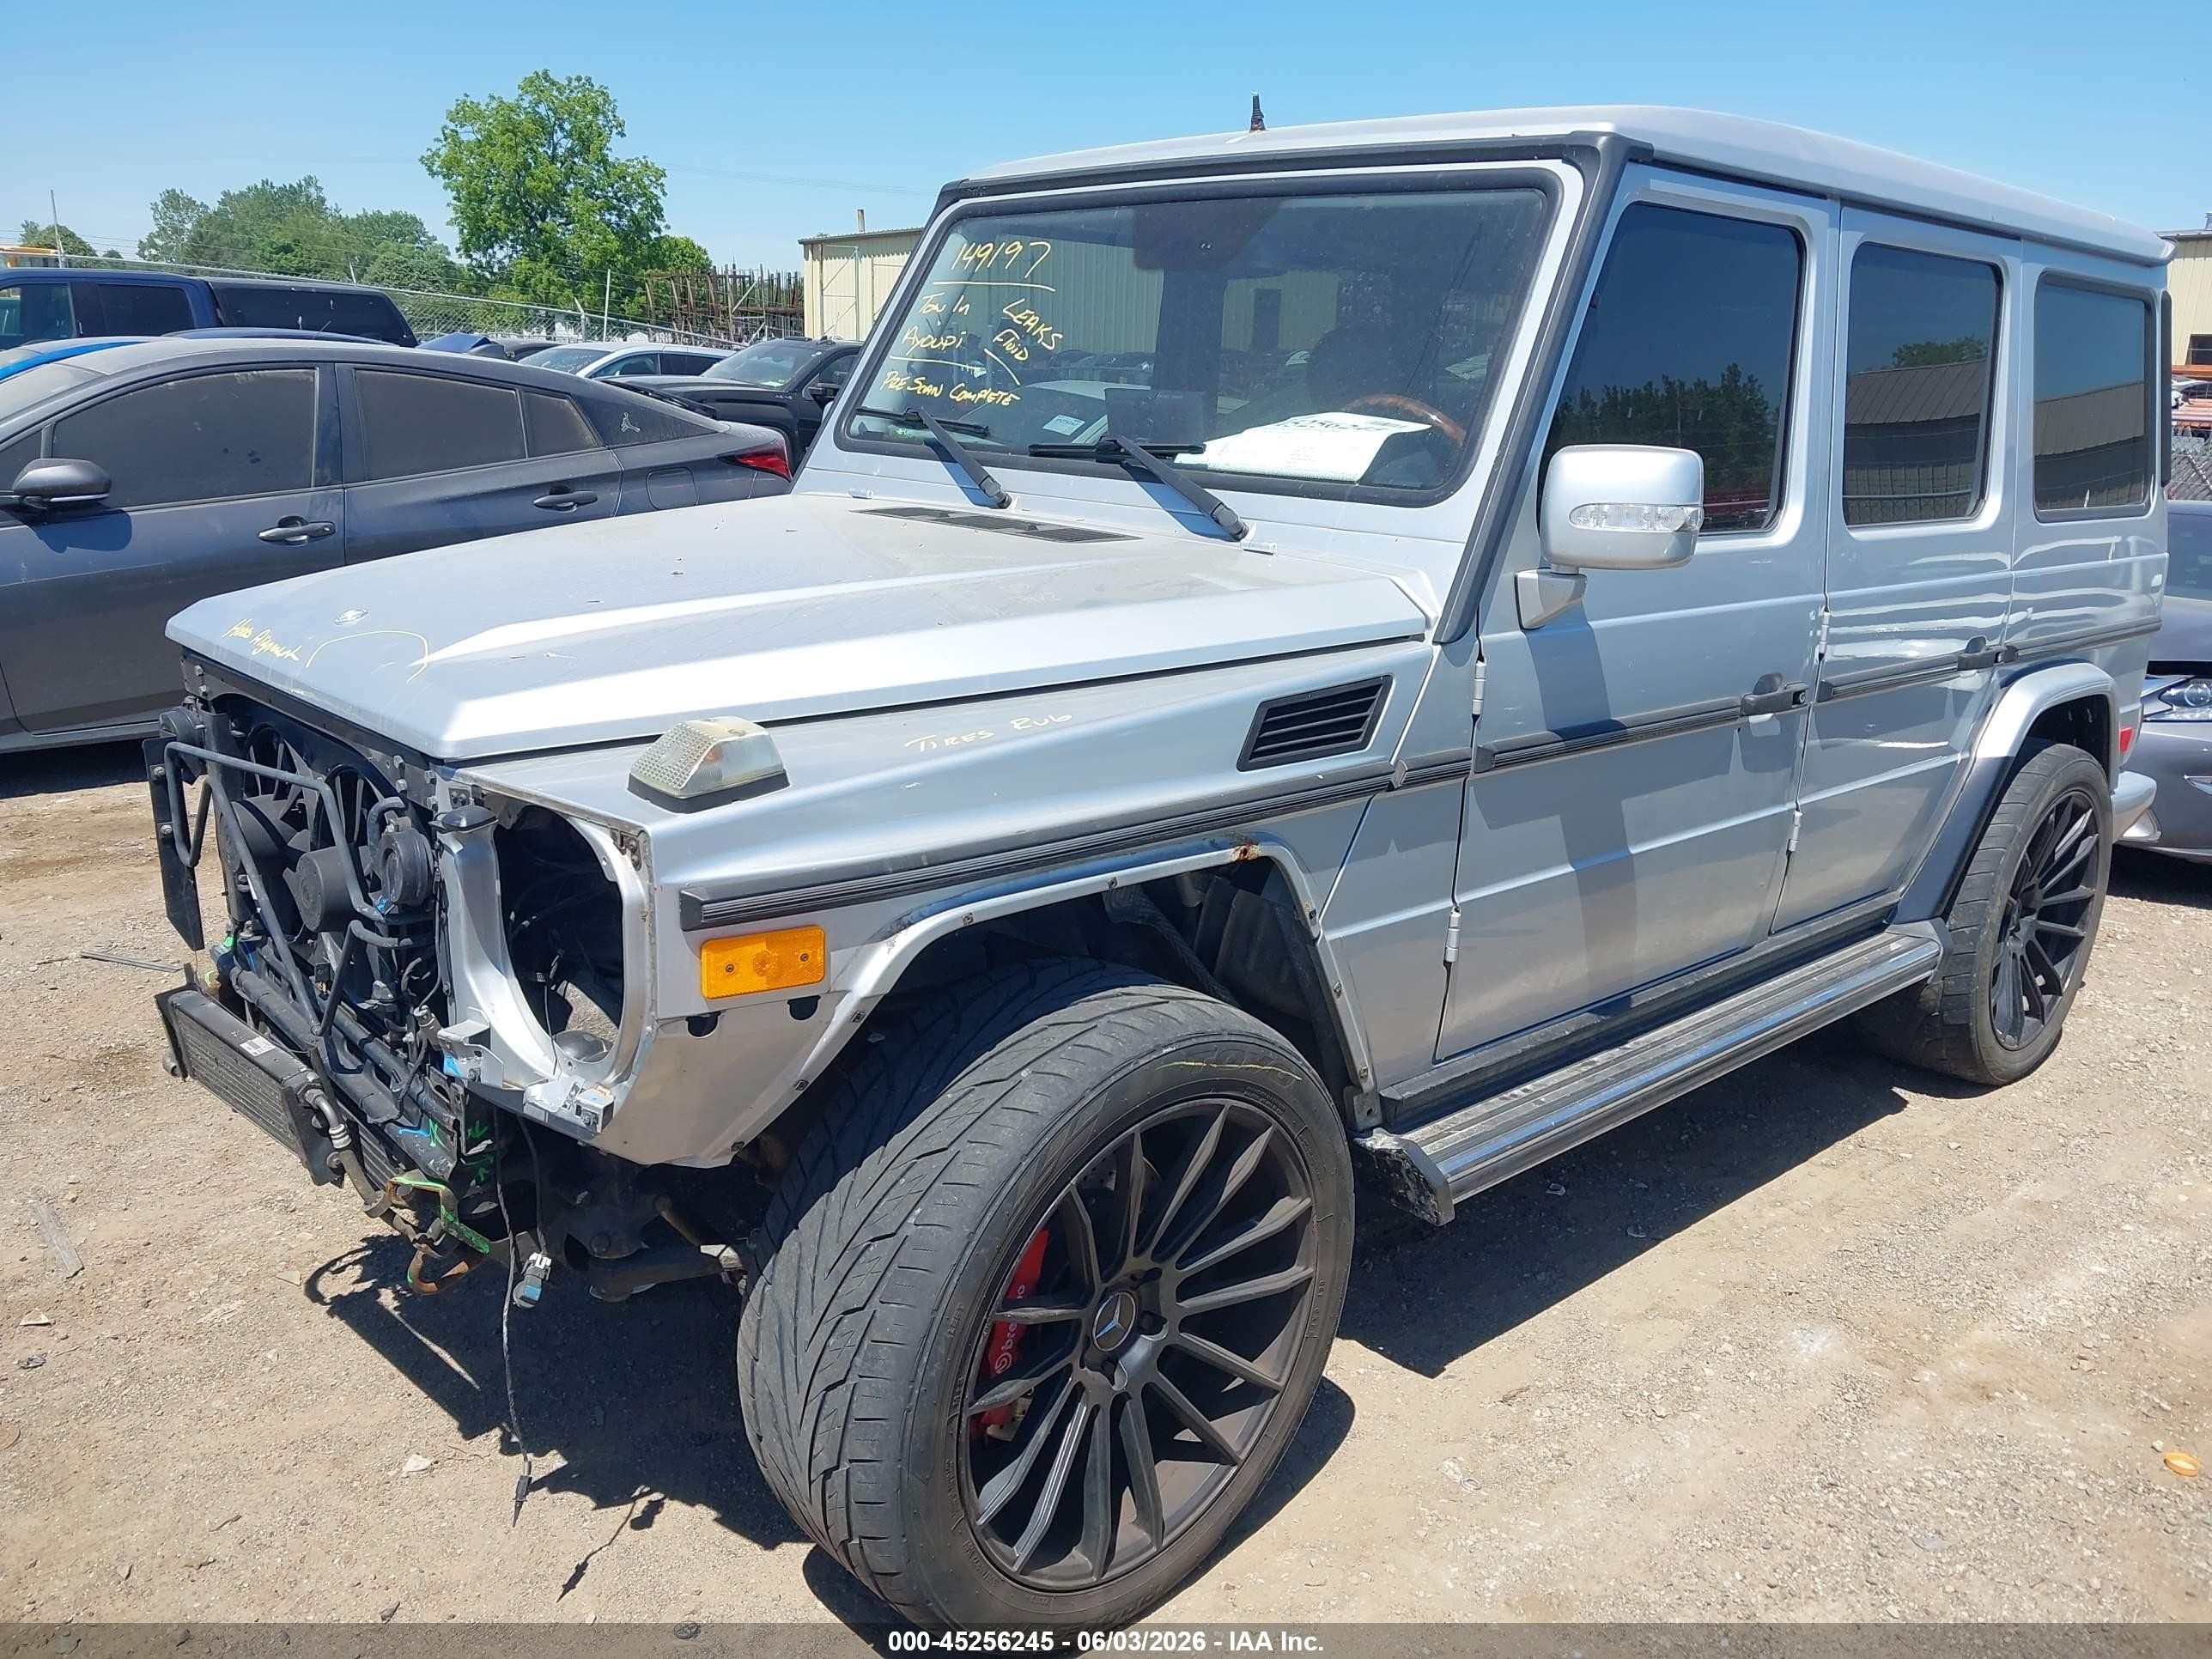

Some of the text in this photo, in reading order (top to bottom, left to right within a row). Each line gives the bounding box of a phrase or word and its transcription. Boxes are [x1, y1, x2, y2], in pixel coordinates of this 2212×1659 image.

[951, 241, 1051, 279] 149197
[1003, 298, 1064, 351] LEAKS
[903, 730, 994, 752] TIRES
